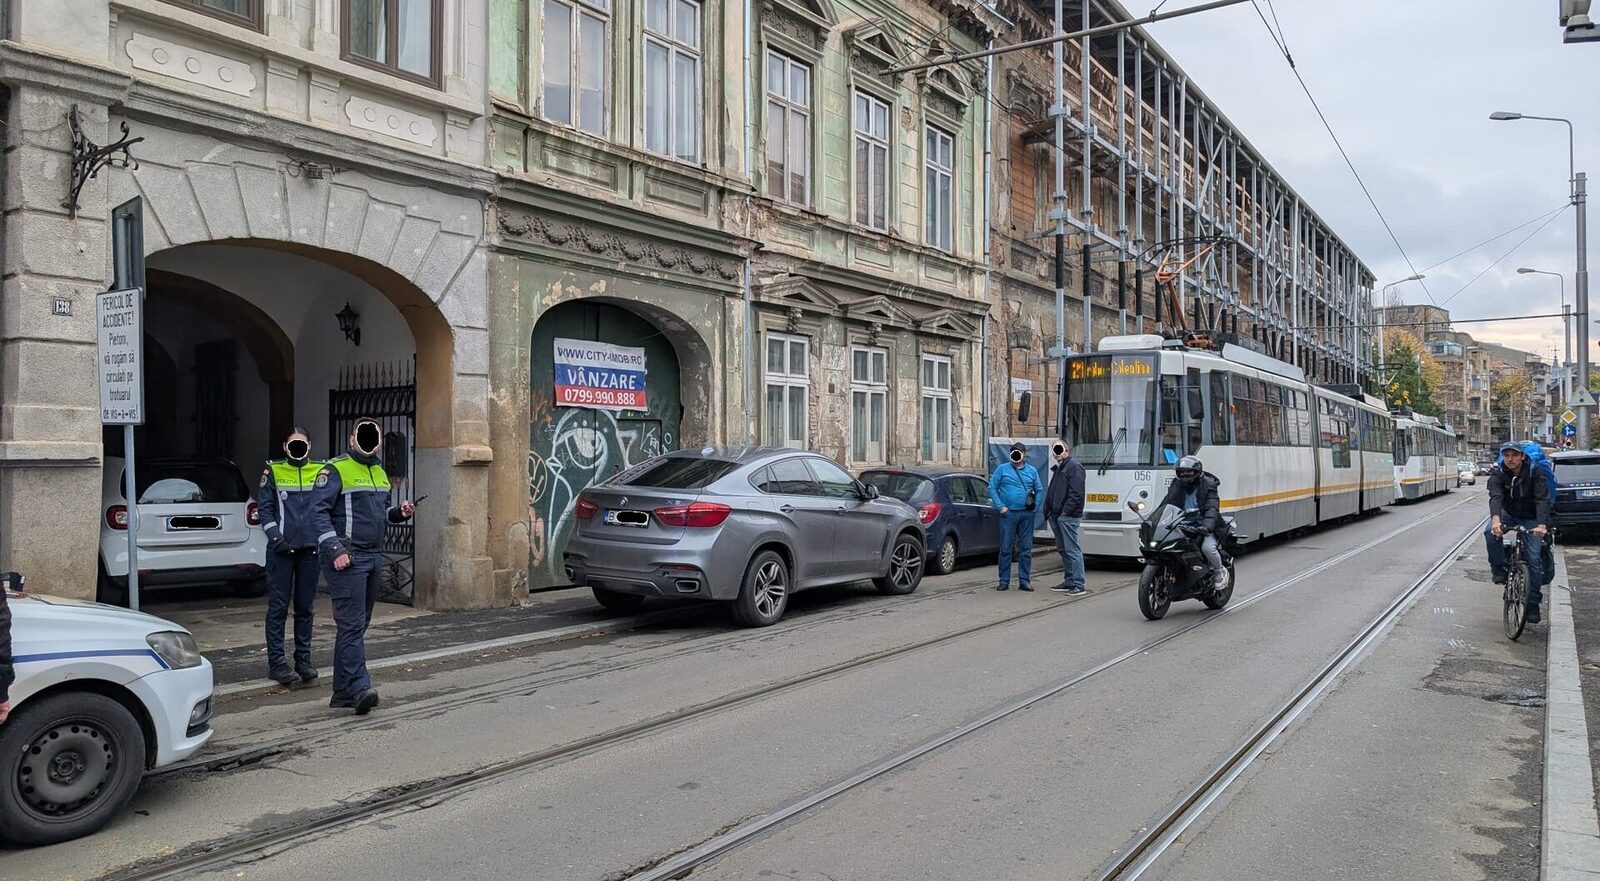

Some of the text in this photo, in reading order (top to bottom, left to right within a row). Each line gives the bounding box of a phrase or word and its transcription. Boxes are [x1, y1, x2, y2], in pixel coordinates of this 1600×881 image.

[103, 293, 133, 311] PERICOL DE
[103, 310, 135, 328] ACCIDENTE!
[109, 332, 129, 347] Pietoni,
[567, 366, 637, 390] VÂNZARE
[109, 387, 131, 401] trotuarul
[564, 388, 636, 405] 0799.990.888
[103, 406, 109, 420] de
[1134, 471, 1151, 481] 056
